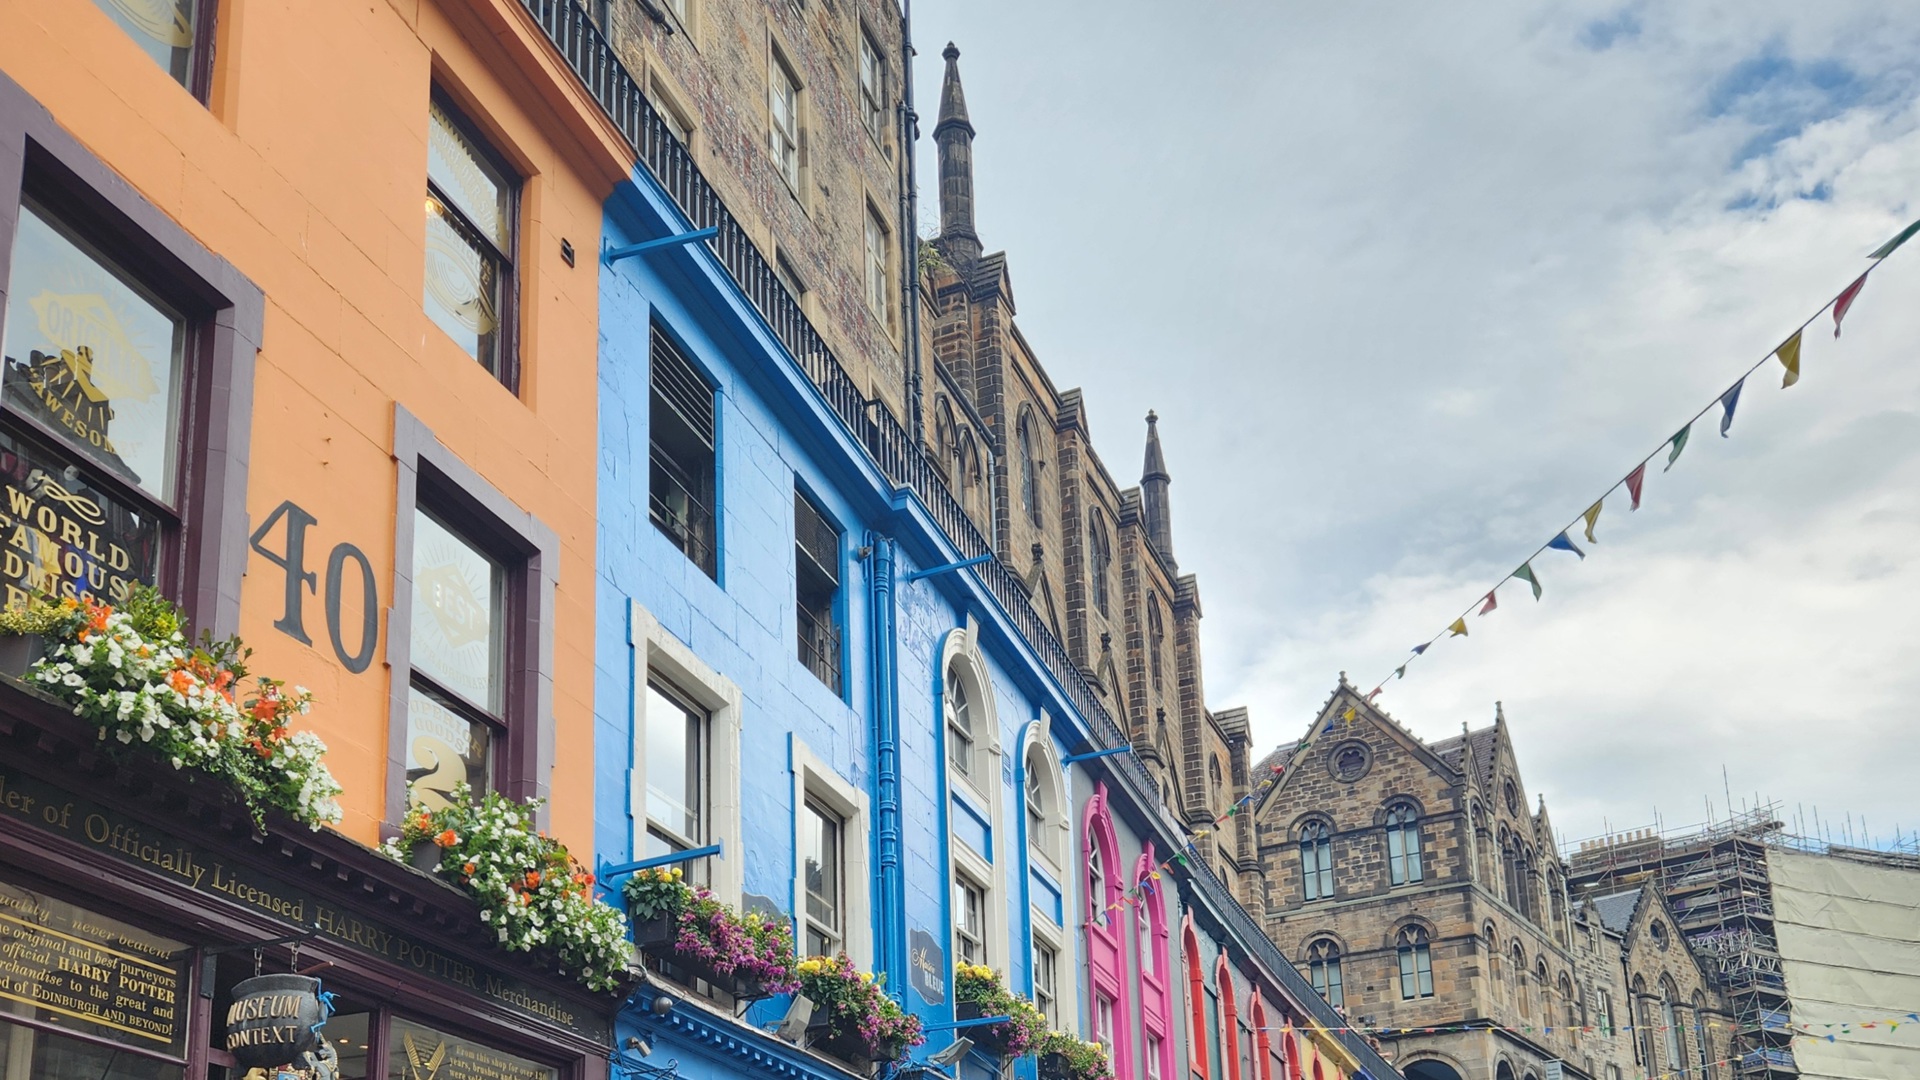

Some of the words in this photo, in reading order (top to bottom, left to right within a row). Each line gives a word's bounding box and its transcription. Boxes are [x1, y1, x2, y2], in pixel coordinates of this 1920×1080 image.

[47, 299, 148, 393] ORIGINAL
[6, 485, 129, 572] WORLD
[250, 500, 378, 674] 40
[431, 580, 477, 630] BEST
[42, 803, 74, 829] of
[85, 814, 206, 889] Officially
[211, 862, 304, 922] Licensed
[316, 905, 392, 955] HARRY
[397, 939, 477, 990] POTTER
[485, 974, 574, 1025] Merchandise
[13, 929, 66, 954] original
[69, 947, 91, 961] and
[94, 951, 118, 970] best
[120, 963, 176, 988] purveyors
[72, 919, 115, 940] never
[118, 932, 172, 960] beaten!
[2, 942, 50, 965] official
[58, 956, 112, 984] HARRY
[119, 975, 175, 1005] POTTER
[924, 970, 944, 997] BLEUE
[14, 980, 28, 994] of
[32, 983, 99, 1015] EDINBURGH
[103, 1008, 125, 1022] AND
[129, 1013, 173, 1035] BEYOND!
[70, 979, 82, 992] to
[90, 985, 109, 1000] the
[115, 994, 147, 1012] great
[153, 1006, 174, 1020] and
[226, 995, 302, 1027] MUSEUM
[226, 1025, 298, 1049] CONTEXT
[456, 1045, 475, 1058] From
[476, 1052, 490, 1063] this
[491, 1057, 507, 1071] shop
[508, 1062, 519, 1073] for
[449, 1057, 471, 1071] years,
[472, 1062, 499, 1078] brushes
